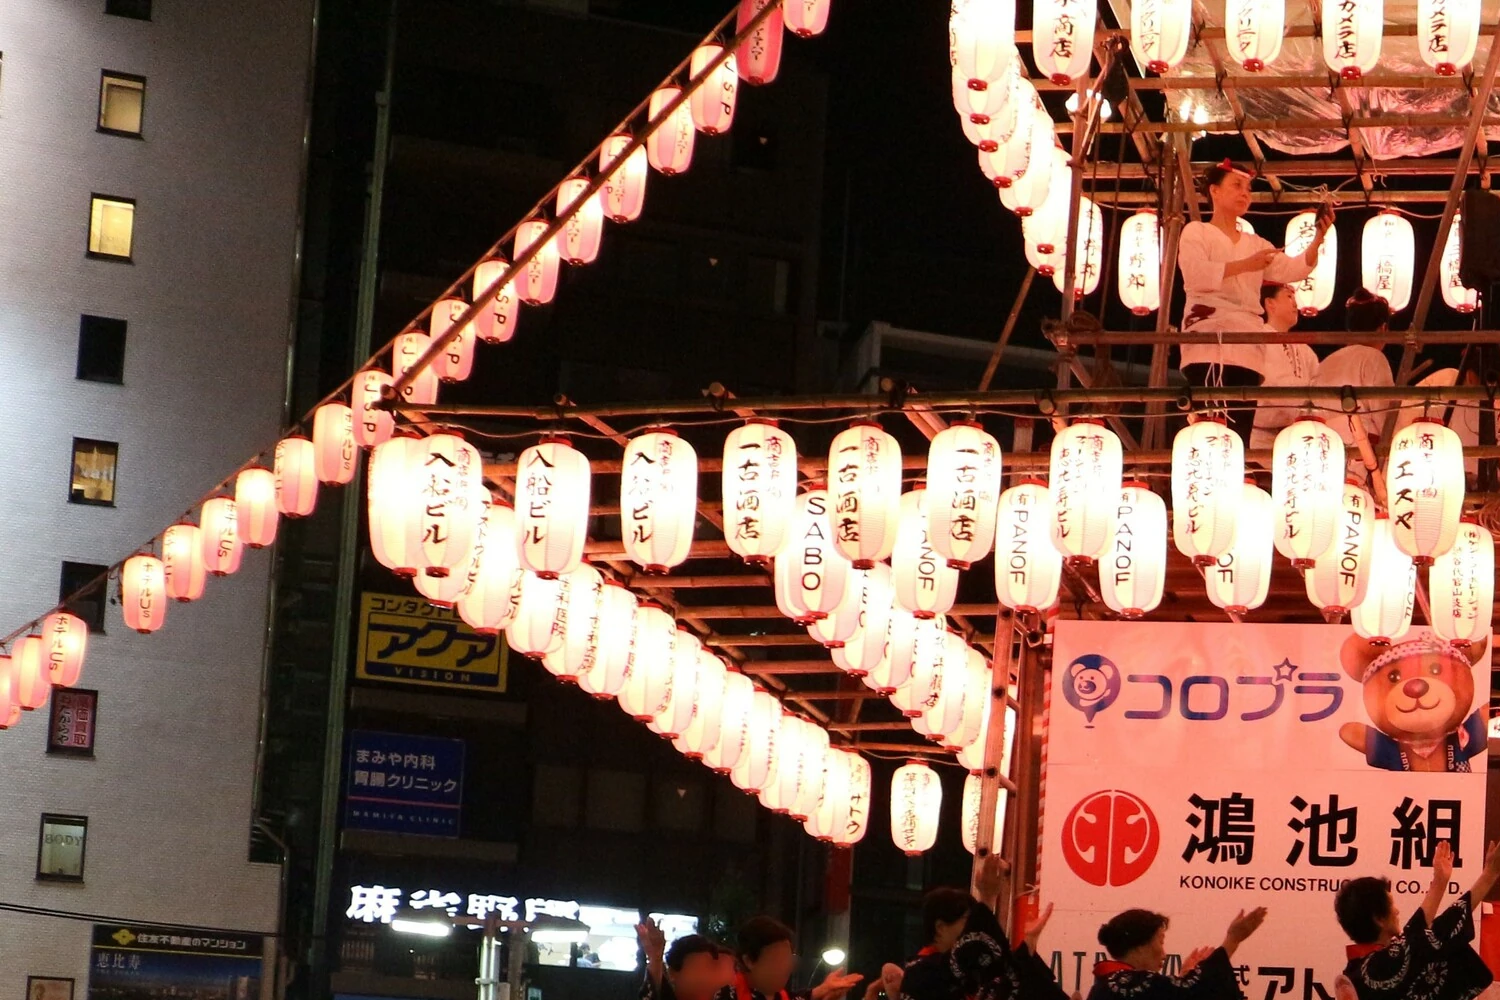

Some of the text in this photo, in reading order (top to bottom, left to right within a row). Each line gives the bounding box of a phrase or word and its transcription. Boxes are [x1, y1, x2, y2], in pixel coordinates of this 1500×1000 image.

[801, 495, 828, 592] SABO
[368, 622, 497, 667] アクア
[394, 667, 472, 683] VISION
[1124, 657, 1346, 722] コロプラ
[356, 750, 436, 771] まみや内科
[354, 770, 458, 794] 胃腸クリニック
[1181, 791, 1464, 871] 鴻池組
[1180, 874, 1257, 890] KONOIKE
[1259, 876, 1394, 894] CONSTRUCN
